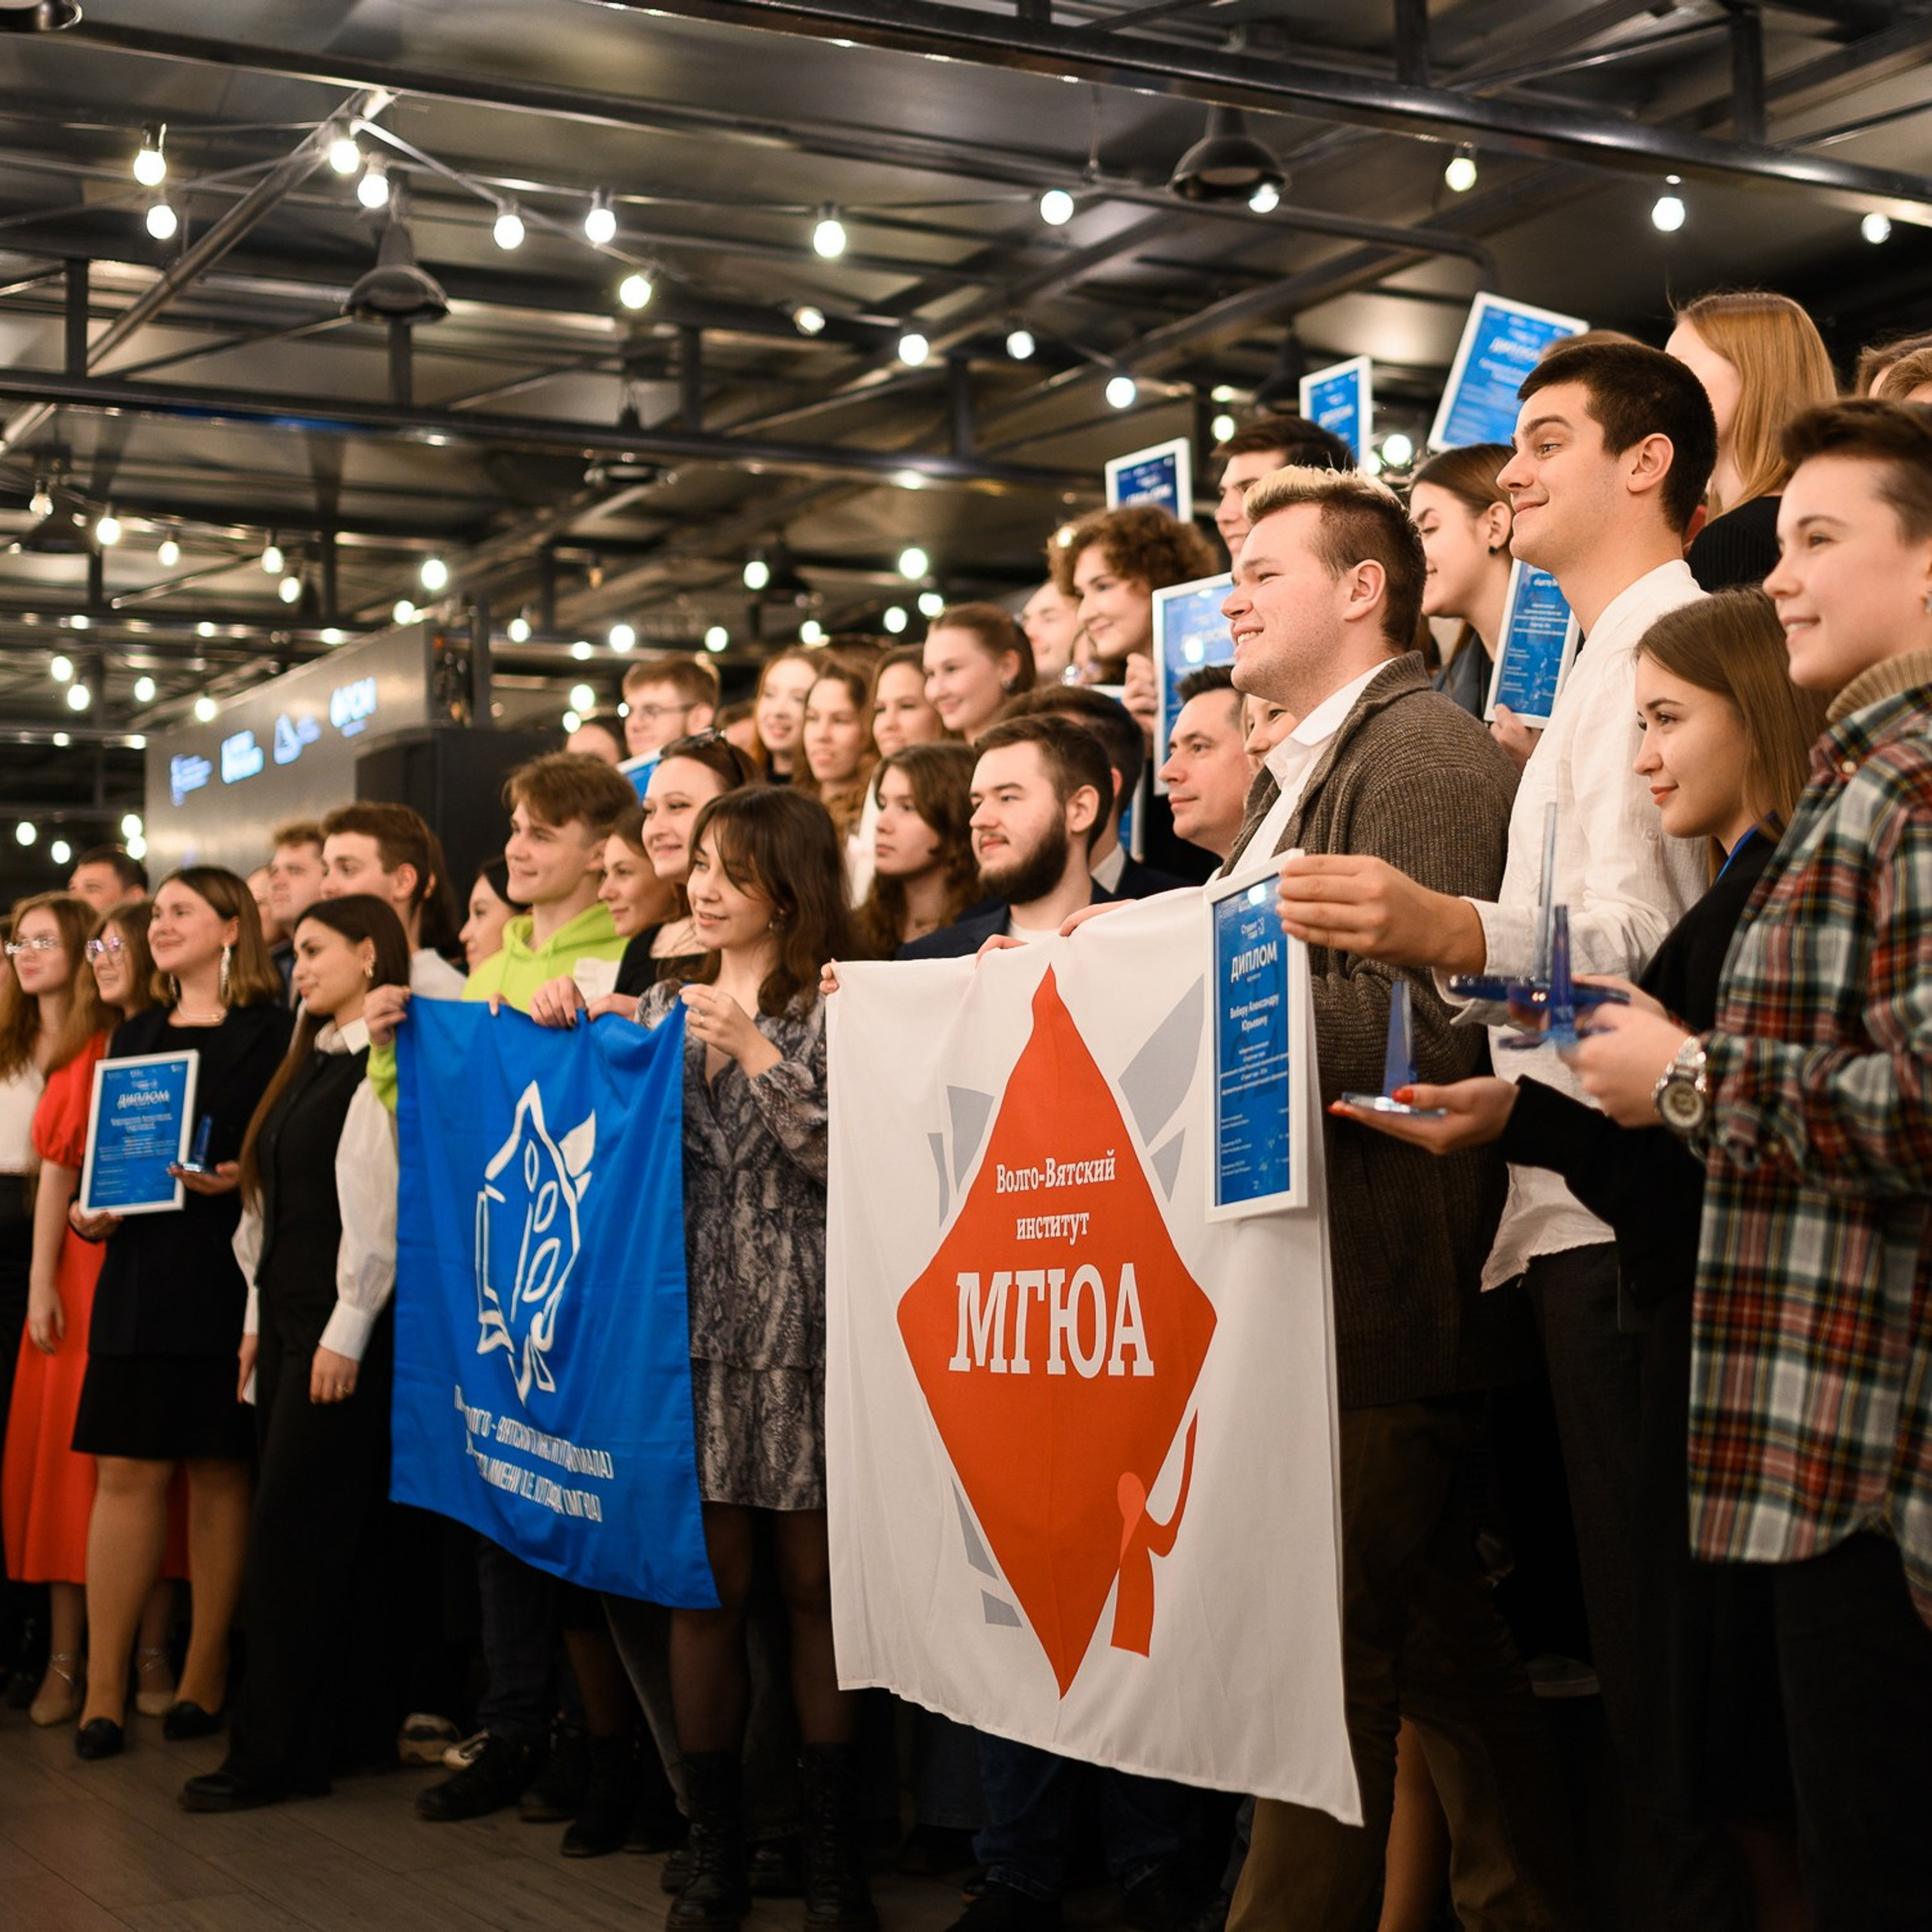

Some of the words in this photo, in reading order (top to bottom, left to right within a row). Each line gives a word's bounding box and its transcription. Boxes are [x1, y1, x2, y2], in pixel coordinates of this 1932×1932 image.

[1231, 940, 1278, 983] ДИПЛОМ
[996, 1149, 1115, 1193] Волго-Вятский
[1016, 1212, 1090, 1245] институт
[949, 1263, 1155, 1379] МГЮА
